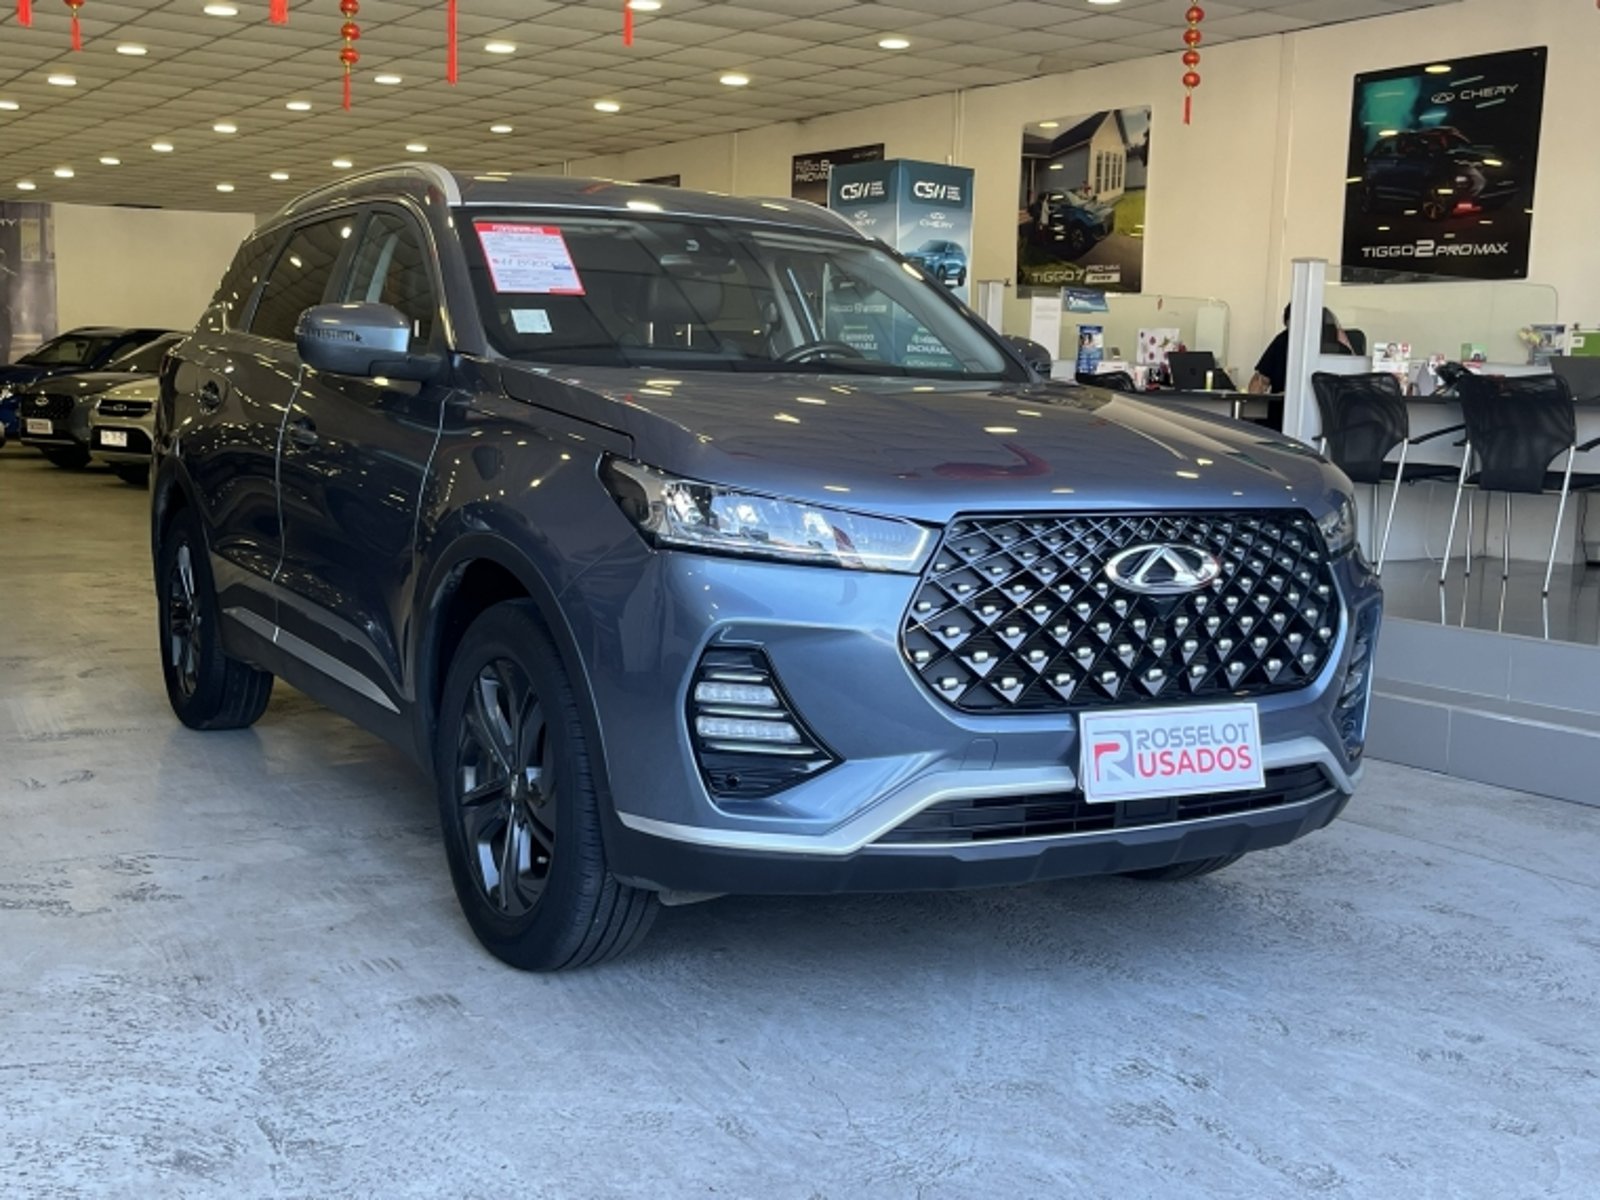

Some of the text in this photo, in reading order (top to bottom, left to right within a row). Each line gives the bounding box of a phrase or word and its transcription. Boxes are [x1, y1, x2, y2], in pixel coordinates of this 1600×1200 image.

[1460, 84, 1519, 100] CHERY
[1361, 244, 1415, 258] TIGGO
[1414, 239, 1435, 258] 2
[1136, 723, 1249, 750] ROSSELOT
[1137, 745, 1252, 777] USADOS
